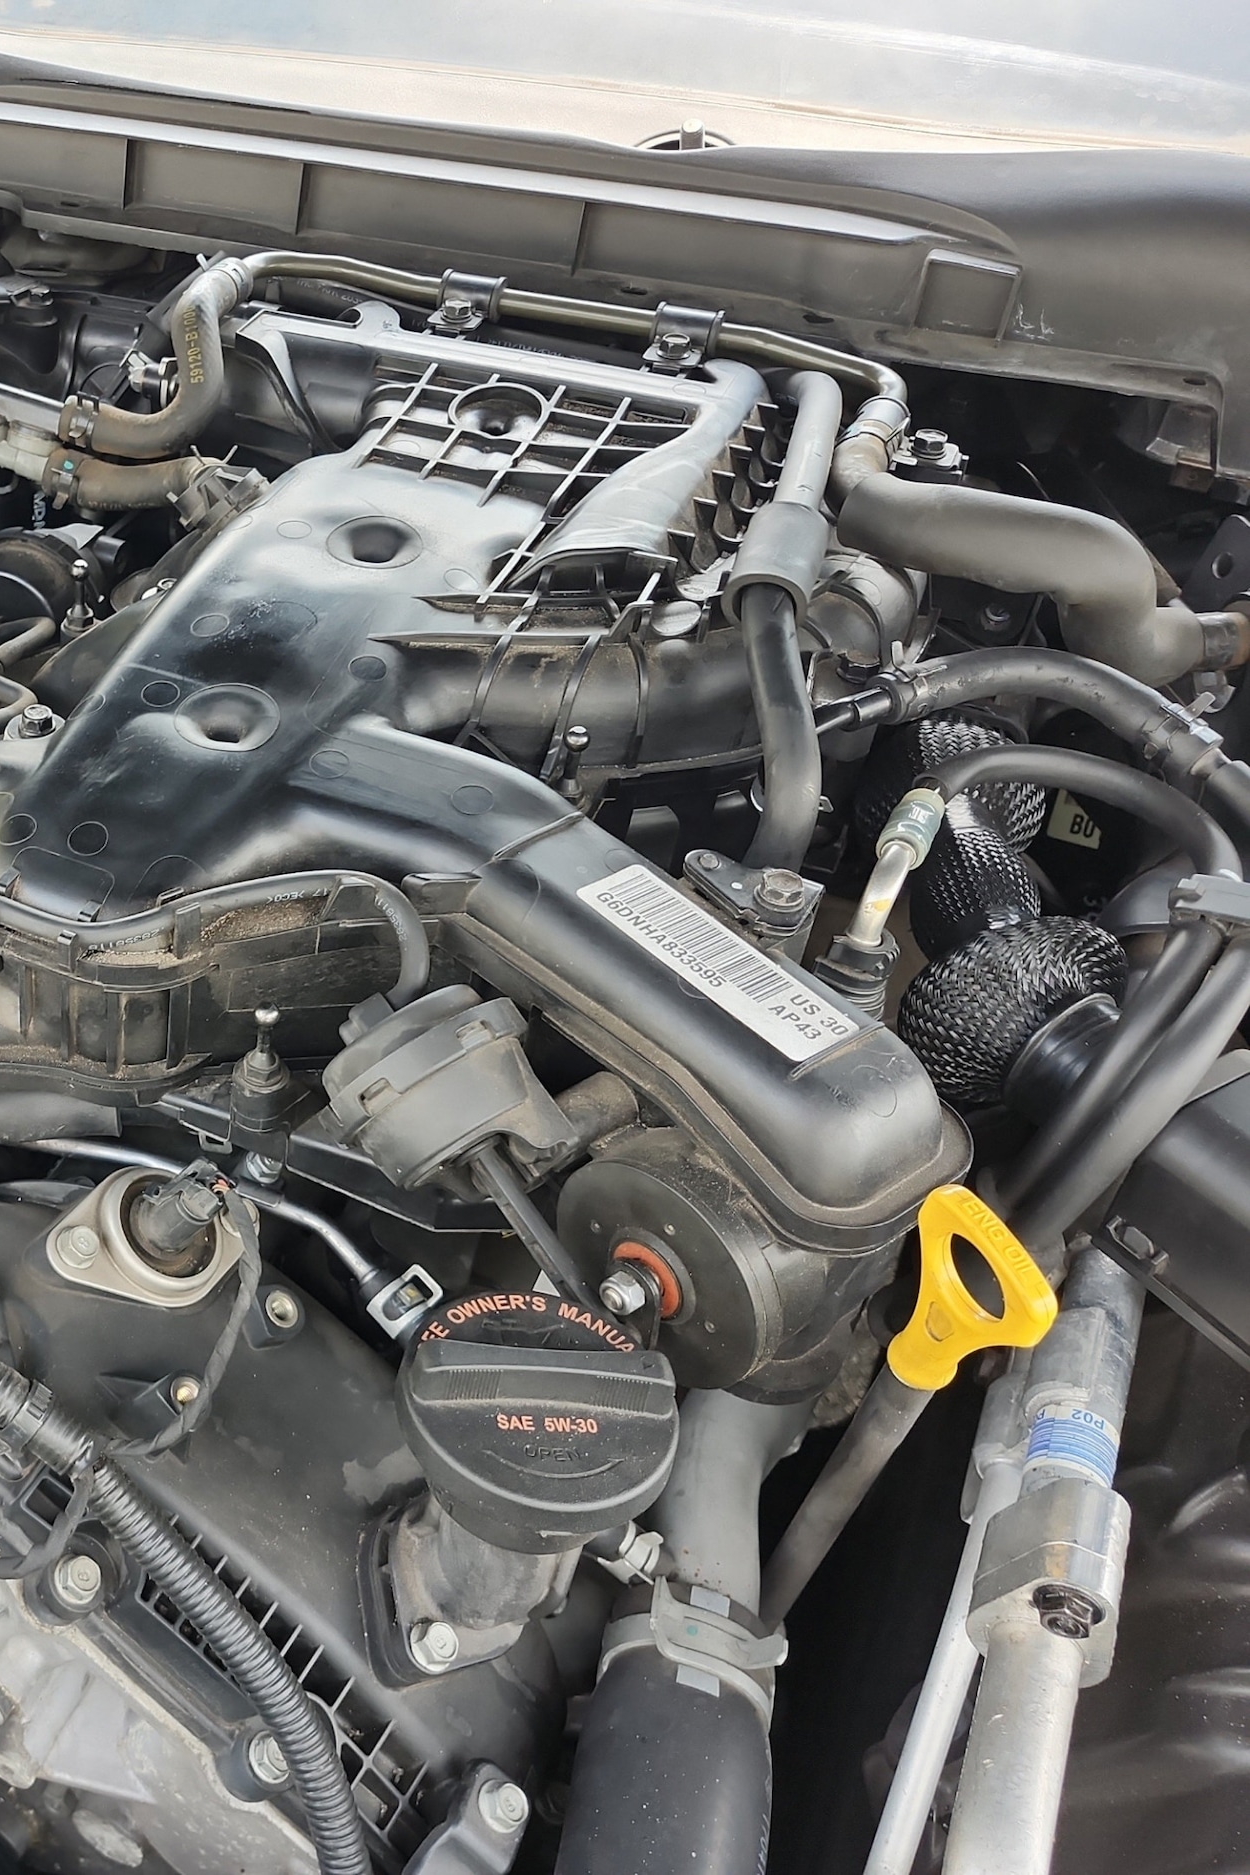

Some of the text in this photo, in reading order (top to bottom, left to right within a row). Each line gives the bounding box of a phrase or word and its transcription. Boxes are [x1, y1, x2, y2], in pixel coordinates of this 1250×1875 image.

[596, 891, 727, 988] G6DNHA833595
[768, 1004, 822, 1040] AP43
[789, 993, 849, 1037] US 30
[964, 1200, 1035, 1282] ENG OIL
[446, 1294, 546, 1325] OWNER'S
[557, 1302, 635, 1352] MANUA
[496, 1414, 598, 1434] SAE 5W-30
